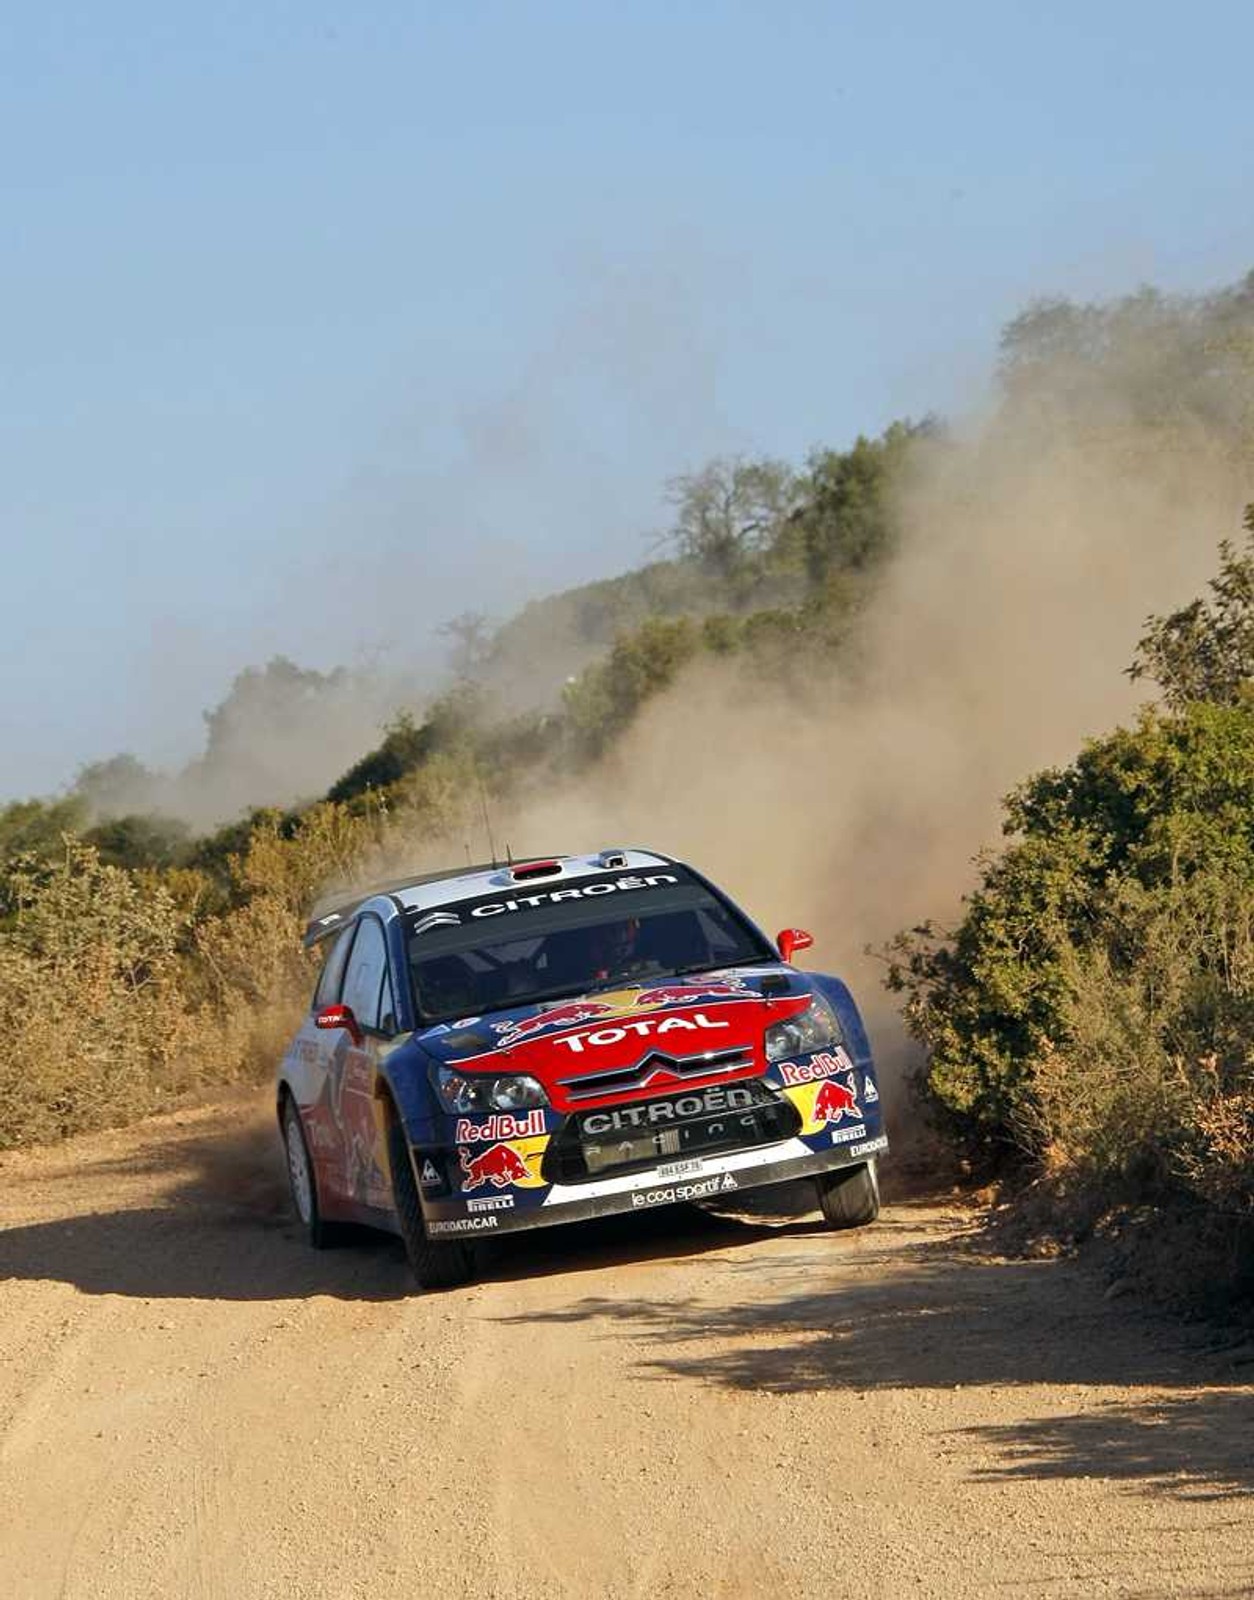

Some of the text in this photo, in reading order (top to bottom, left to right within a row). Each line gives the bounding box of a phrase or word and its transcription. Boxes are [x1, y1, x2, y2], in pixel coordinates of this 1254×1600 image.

[553, 1013, 730, 1053] TOTAL
[466, 1195, 515, 1212] PIRELLI
[632, 1175, 721, 1207] le coq sportif
